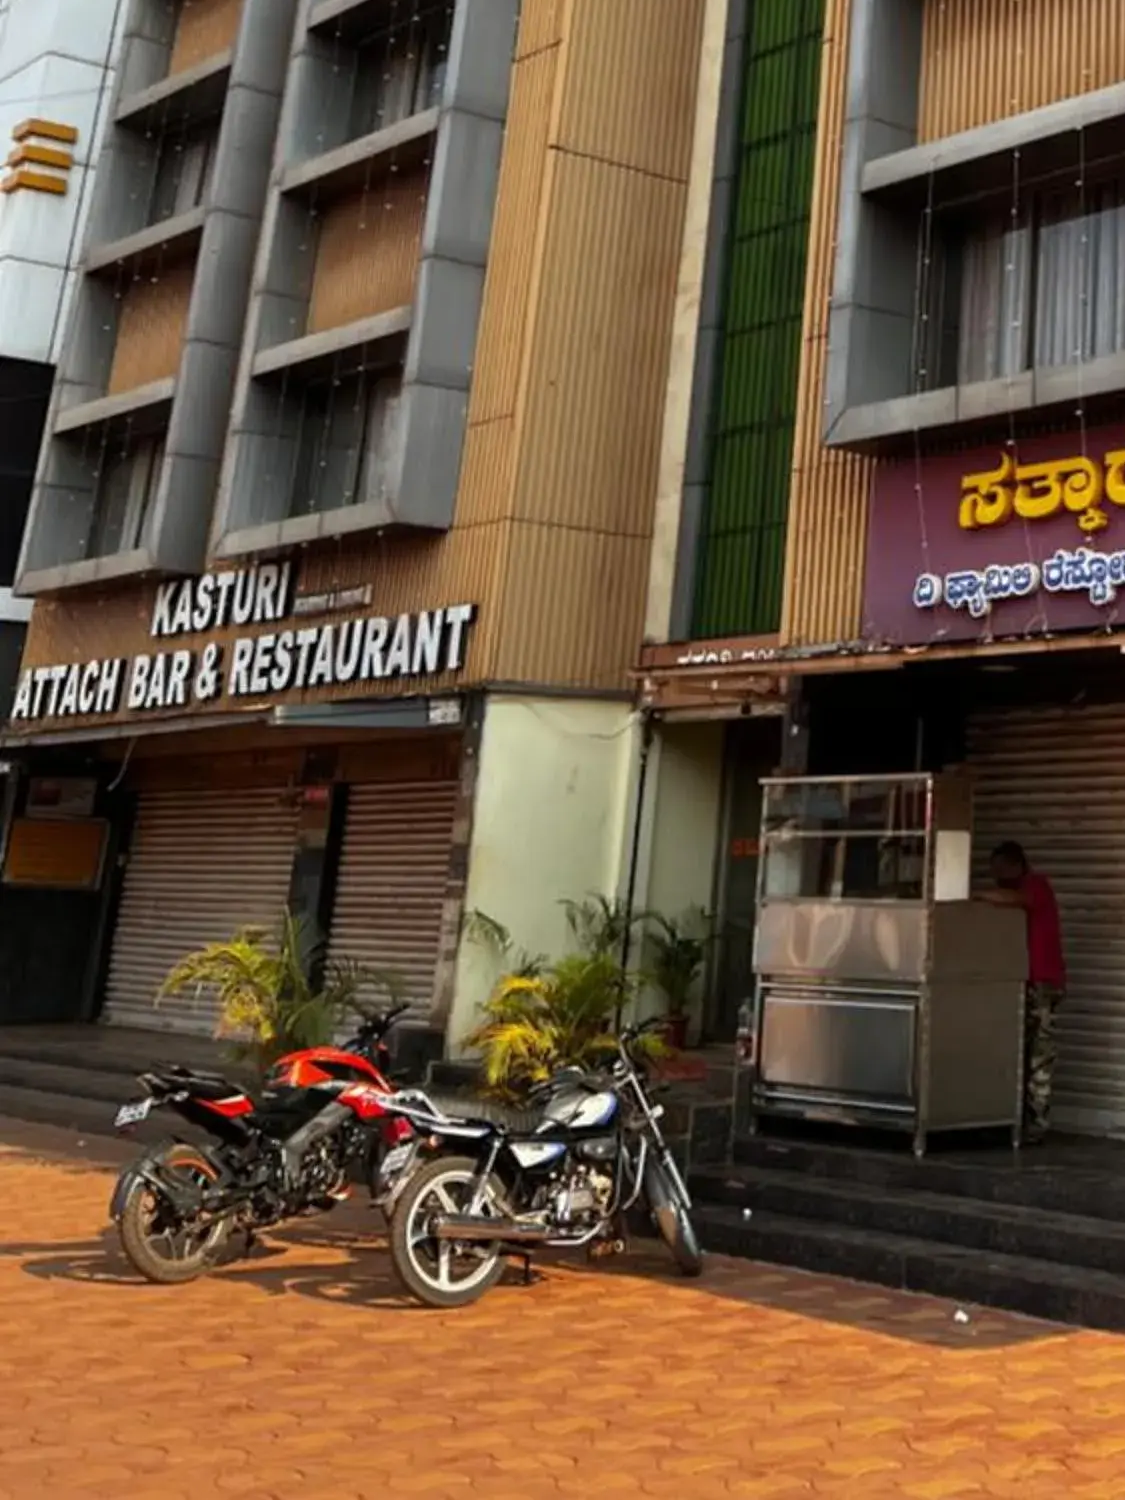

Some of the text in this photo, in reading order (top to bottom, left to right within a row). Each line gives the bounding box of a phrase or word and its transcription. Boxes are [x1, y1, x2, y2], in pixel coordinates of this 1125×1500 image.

[151, 563, 290, 636] KASTURI
[11, 605, 472, 720] ATTACH BAR & RESTAURANT
